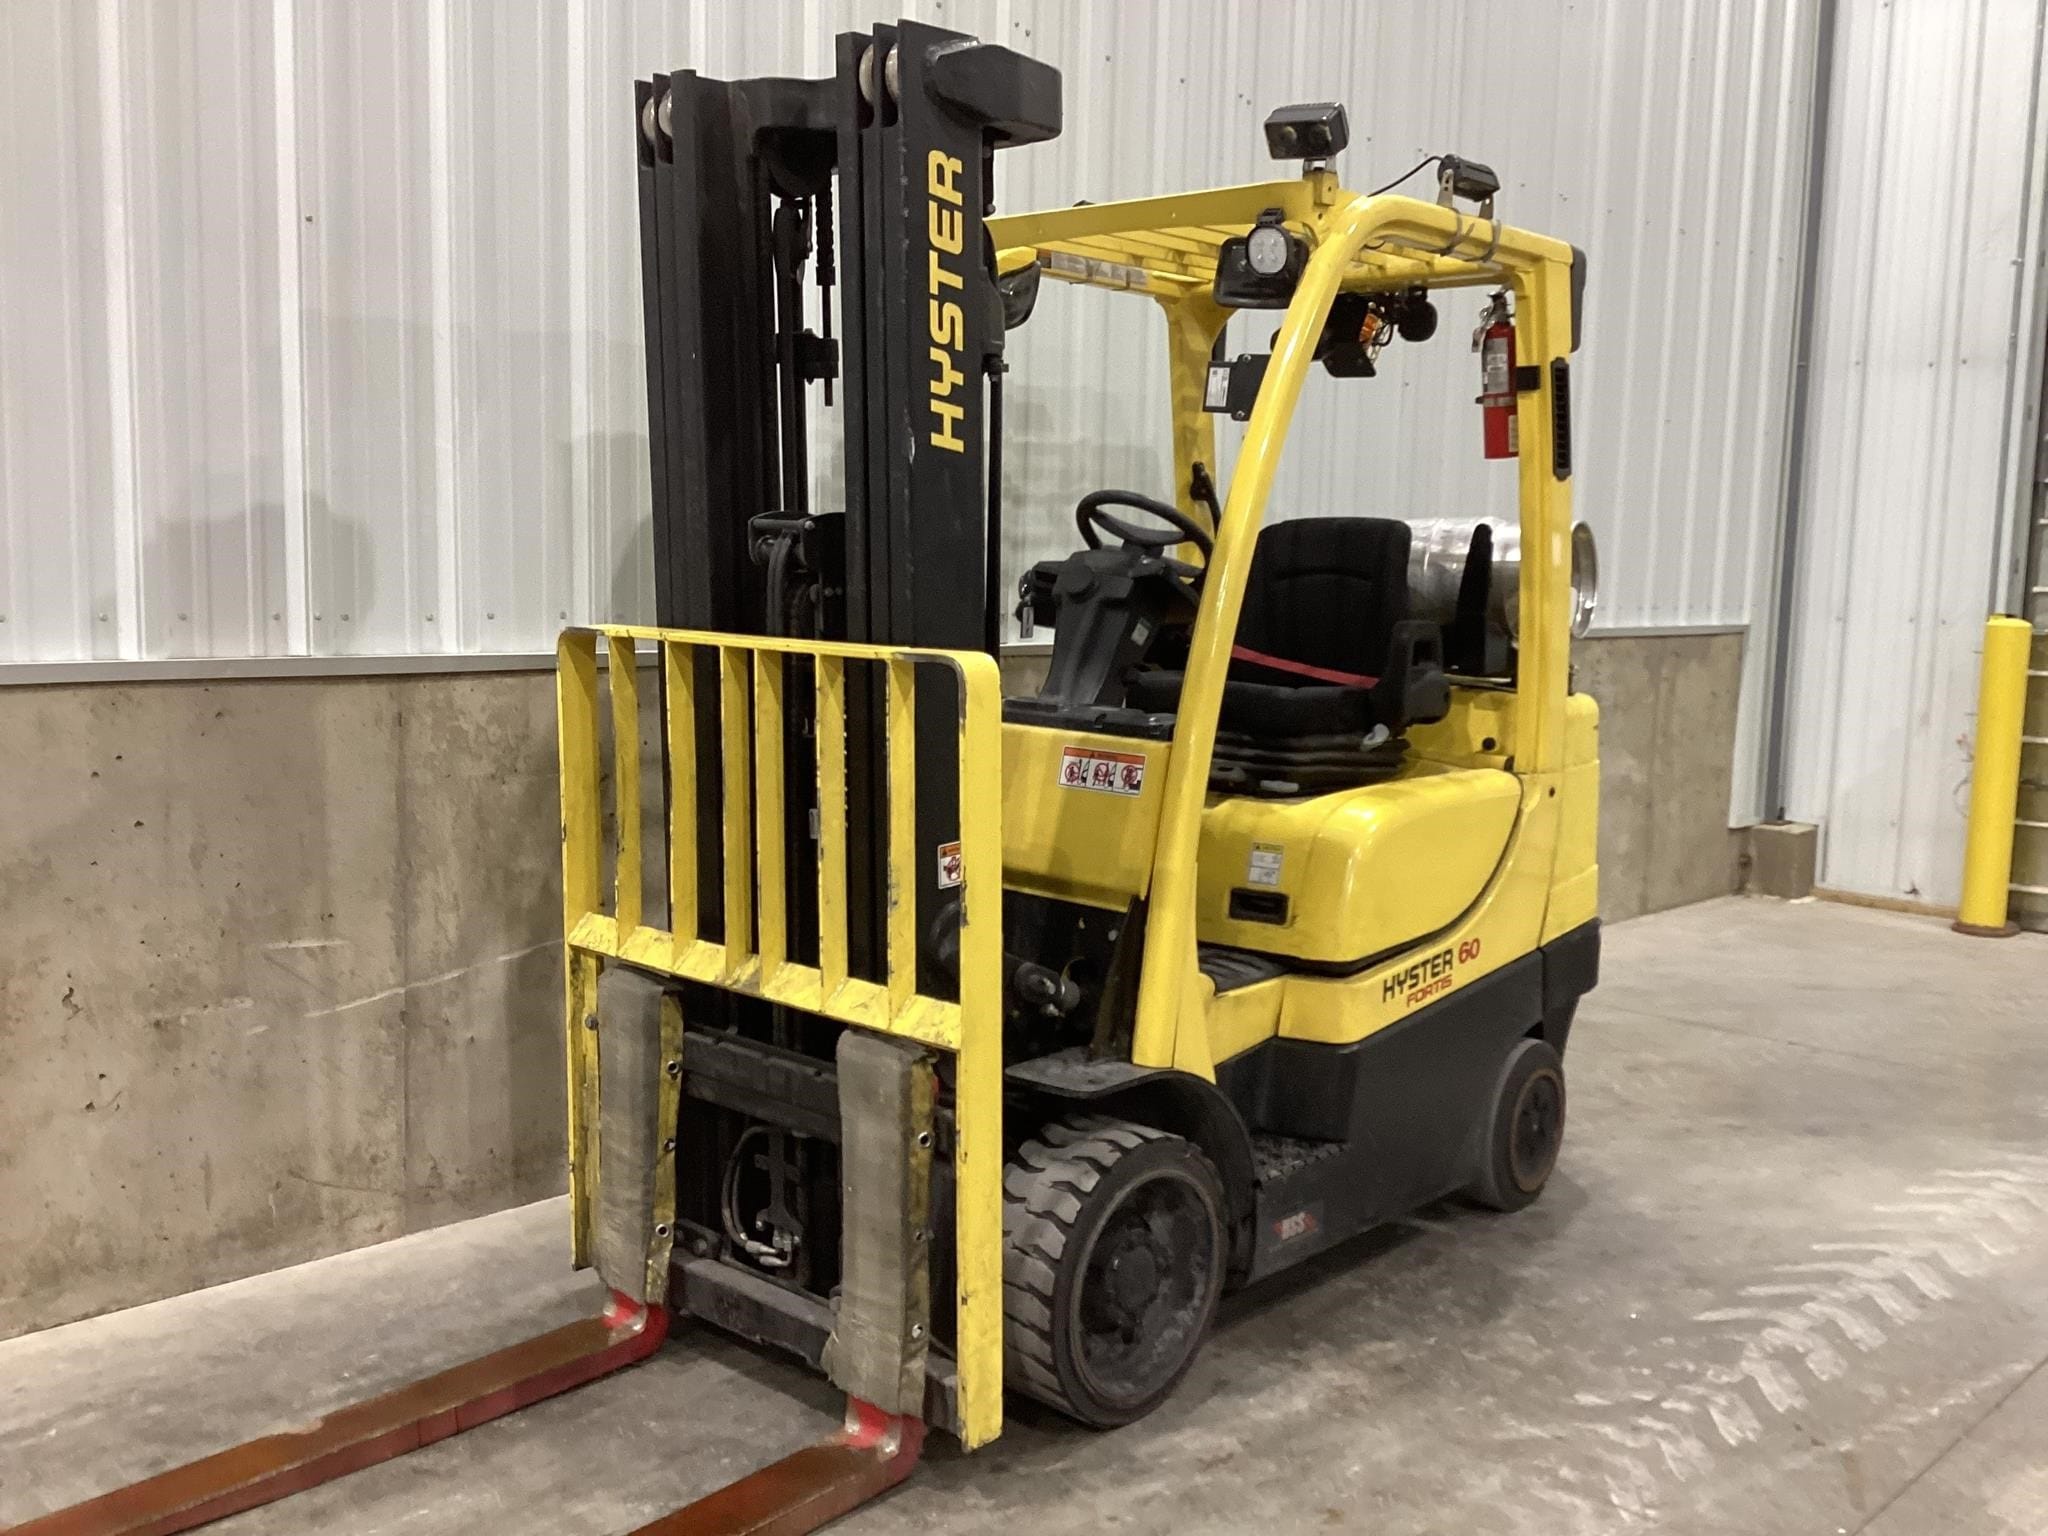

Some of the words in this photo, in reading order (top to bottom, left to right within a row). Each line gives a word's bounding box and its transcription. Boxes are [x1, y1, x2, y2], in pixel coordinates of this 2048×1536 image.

[928, 149, 964, 453] HYSTER
[1382, 948, 1454, 1004] HYSTER
[1458, 937, 1480, 964] 60
[1406, 974, 1453, 1008] FORTIS
